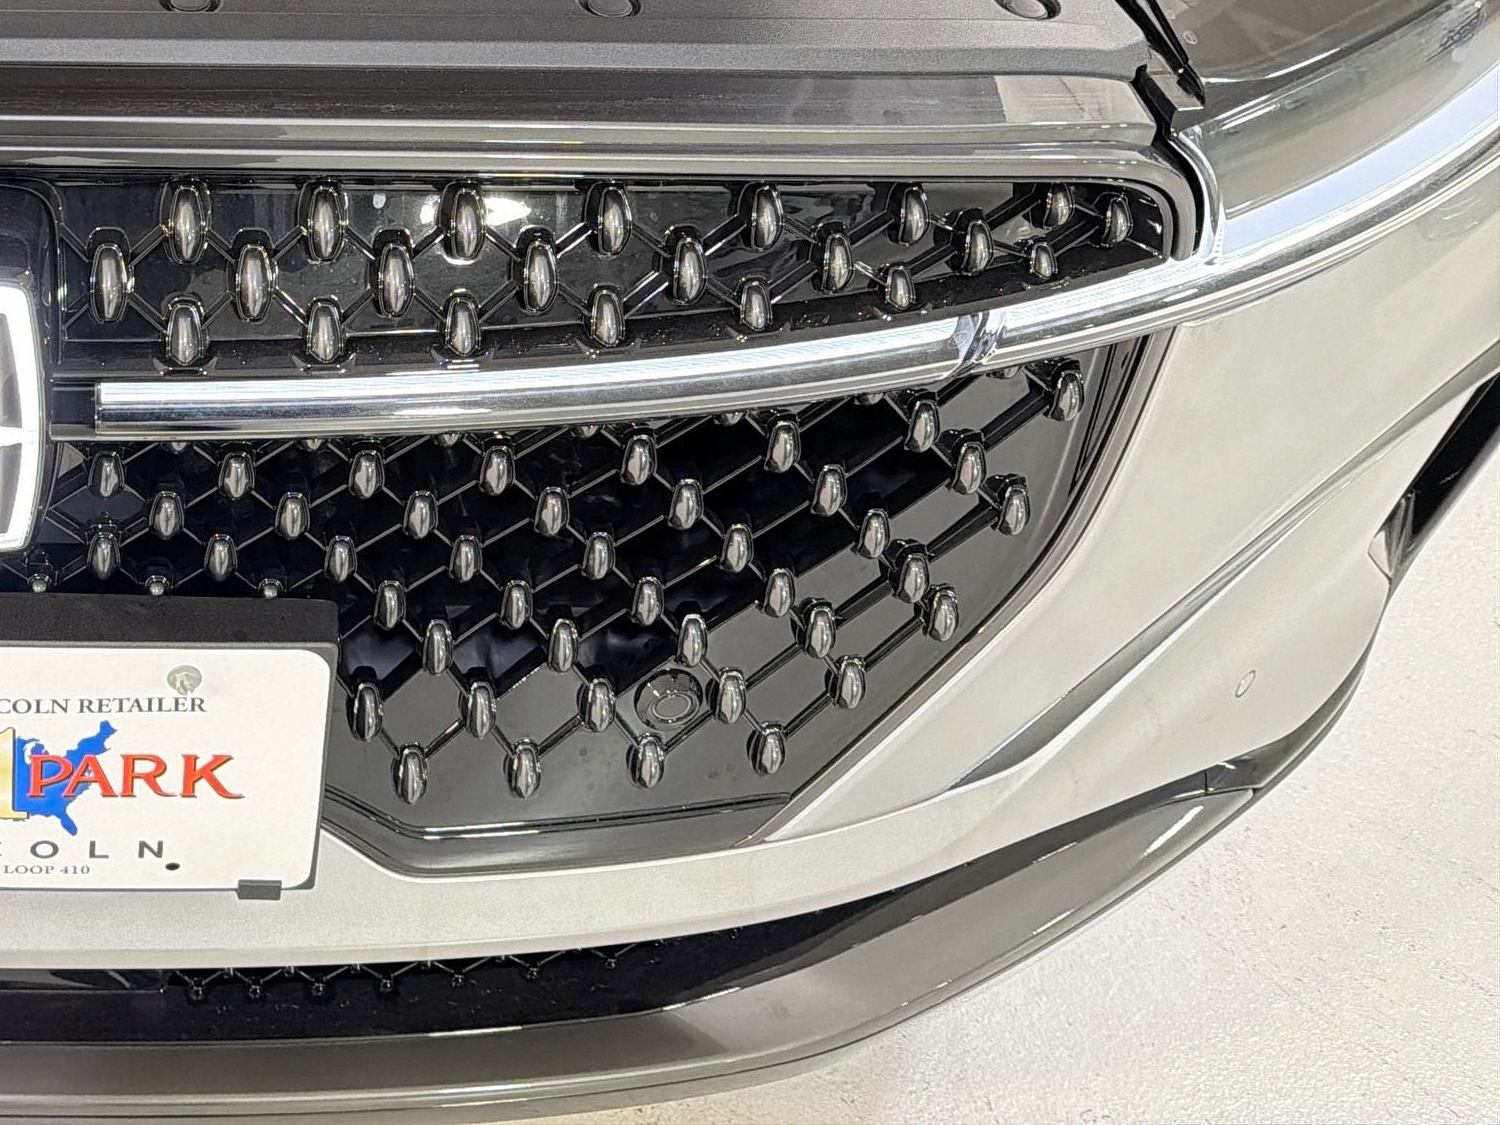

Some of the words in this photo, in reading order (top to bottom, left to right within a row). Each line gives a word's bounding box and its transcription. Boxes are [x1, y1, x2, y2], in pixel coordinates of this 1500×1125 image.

[76, 696, 207, 714] RETAILER
[26, 753, 246, 799] PARK
[3, 864, 55, 874] LOOP
[59, 864, 91, 874] 410
